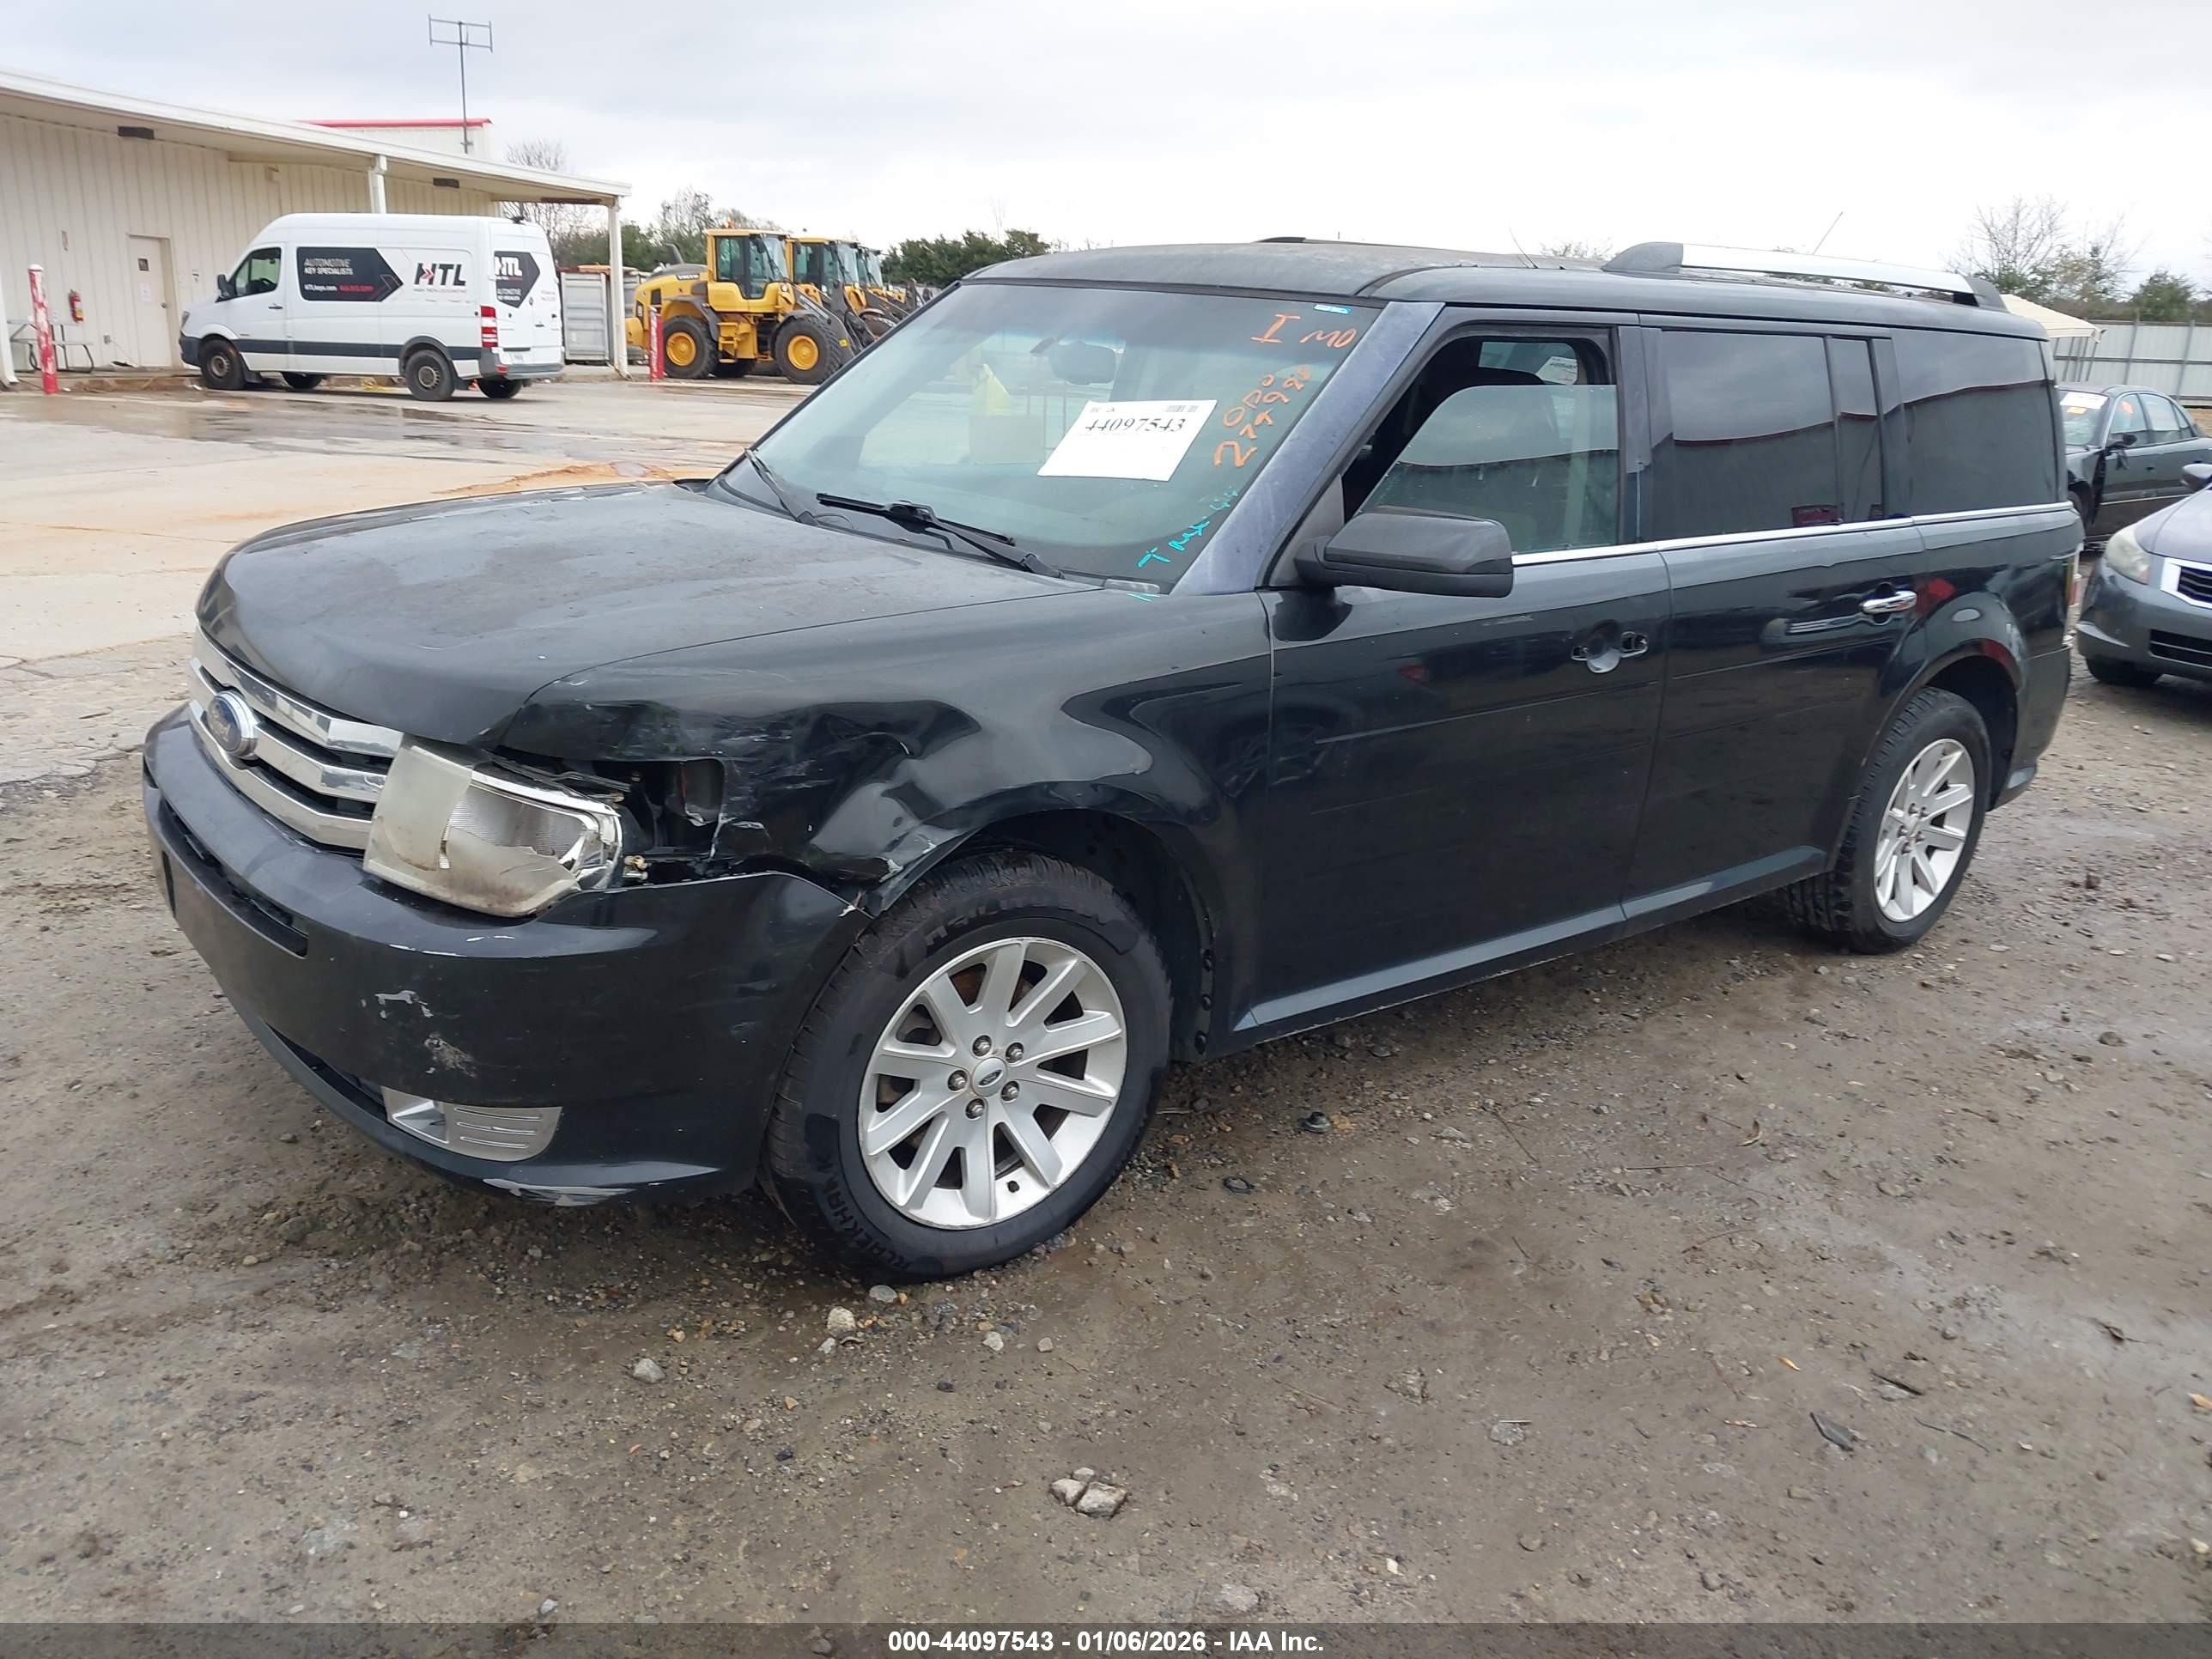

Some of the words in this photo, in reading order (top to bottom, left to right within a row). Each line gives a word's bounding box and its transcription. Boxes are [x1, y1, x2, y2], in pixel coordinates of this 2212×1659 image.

[303, 258, 351, 267] AUTOMOTIVE
[317, 267, 354, 276] SPECIALISTS
[414, 263, 467, 286] HTL
[1085, 417, 1187, 432] 44097543
